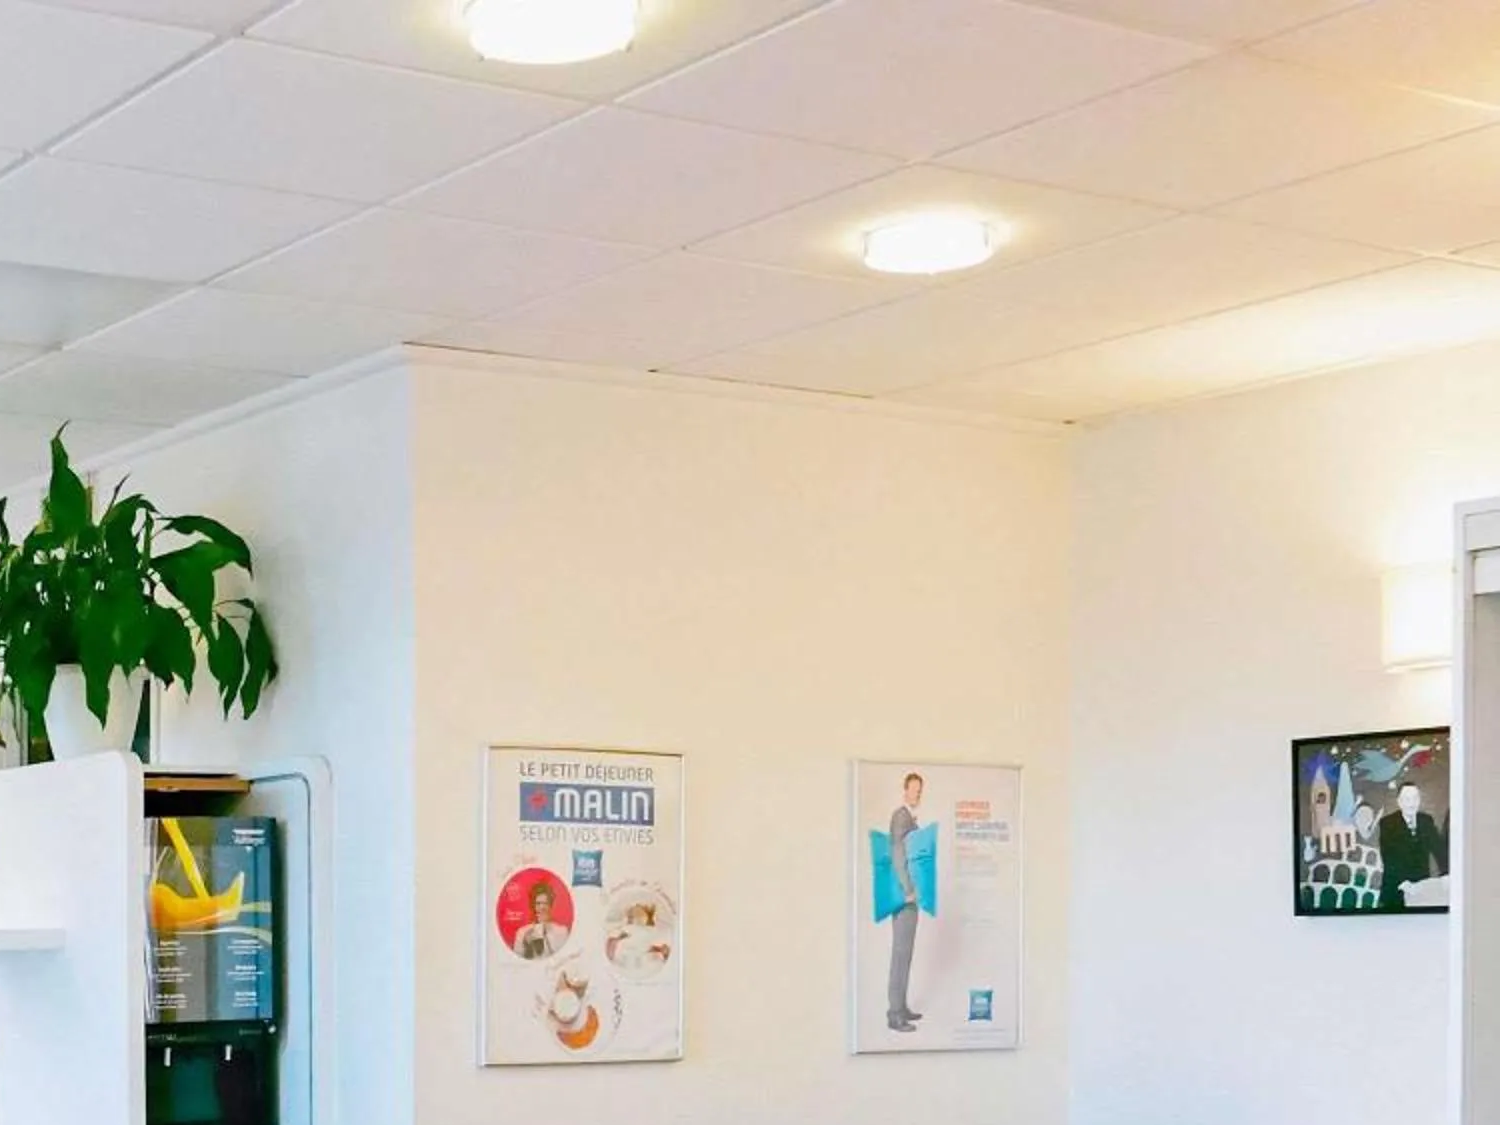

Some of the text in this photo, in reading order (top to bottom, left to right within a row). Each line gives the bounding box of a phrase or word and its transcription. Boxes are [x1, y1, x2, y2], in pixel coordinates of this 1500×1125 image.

[519, 761, 537, 777] LE
[541, 762, 581, 778] PETIT
[553, 787, 650, 822] MALIN
[519, 825, 655, 845] SELON VOS ENVIES
